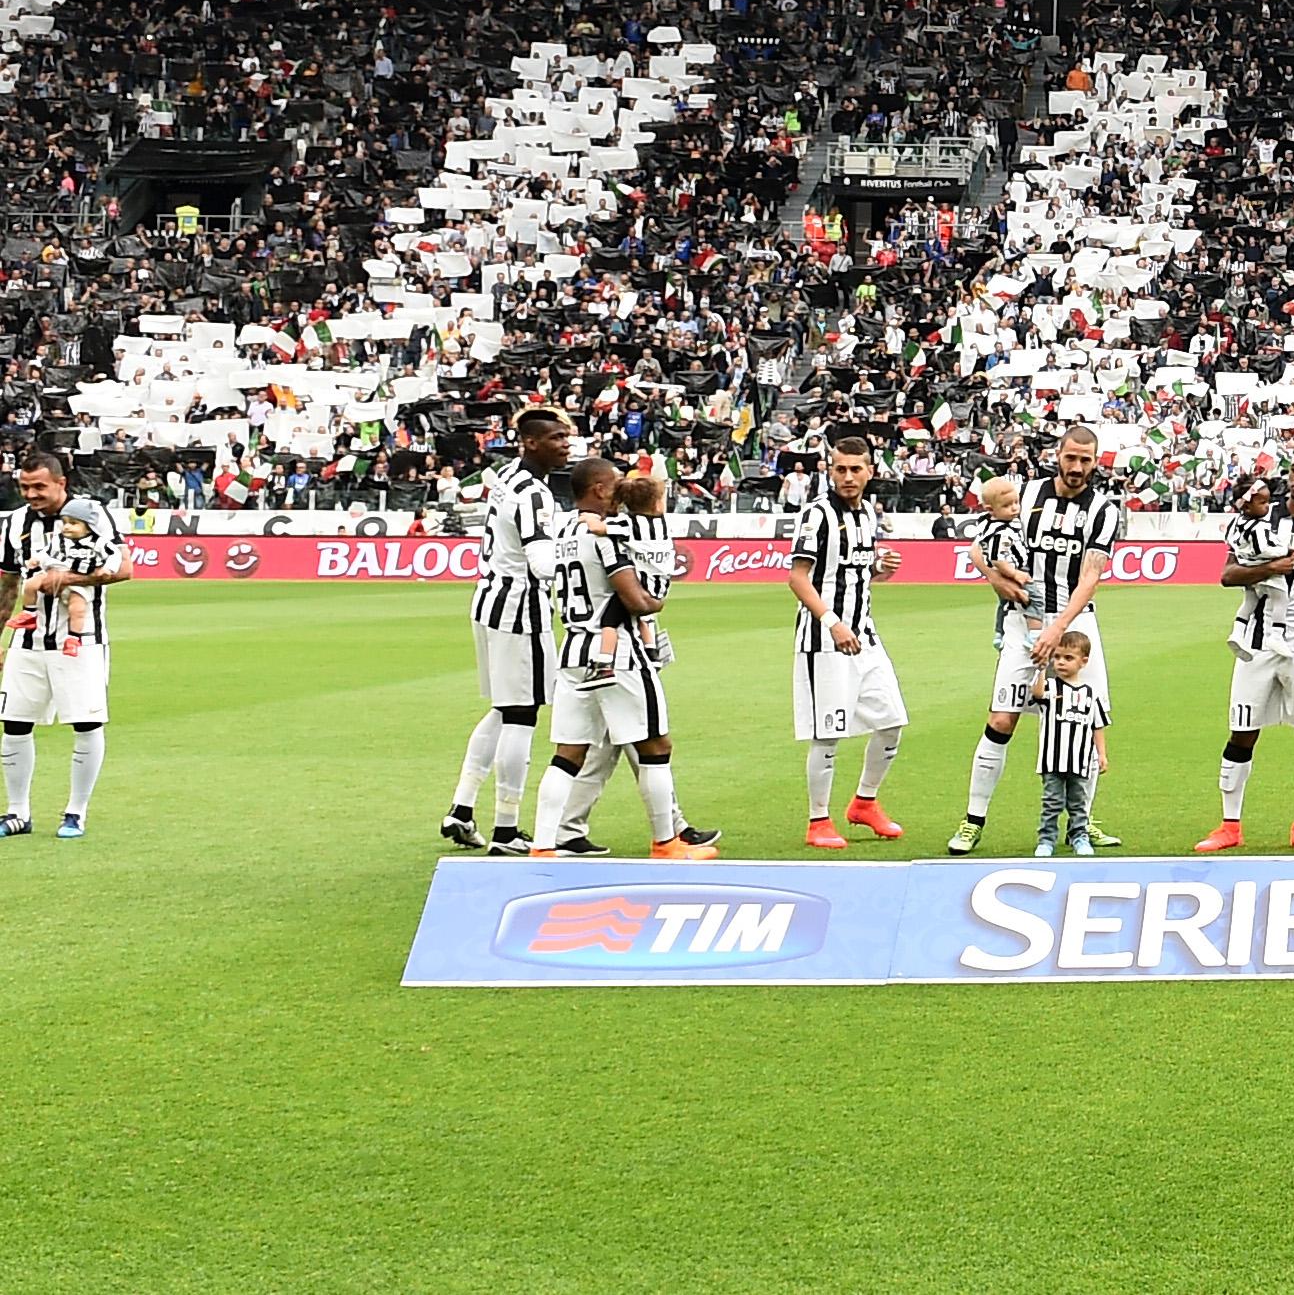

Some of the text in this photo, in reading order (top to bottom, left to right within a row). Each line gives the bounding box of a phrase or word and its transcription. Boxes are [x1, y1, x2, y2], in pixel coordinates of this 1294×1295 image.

[1028, 534, 1082, 557] Jeep
[316, 541, 483, 578] BALOC
[837, 550, 875, 567] Jeep
[1010, 684, 1027, 707] 19
[835, 709, 846, 732] 3
[1055, 708, 1089, 725] Jeep
[1237, 704, 1252, 727] 11
[648, 901, 798, 954] TIM
